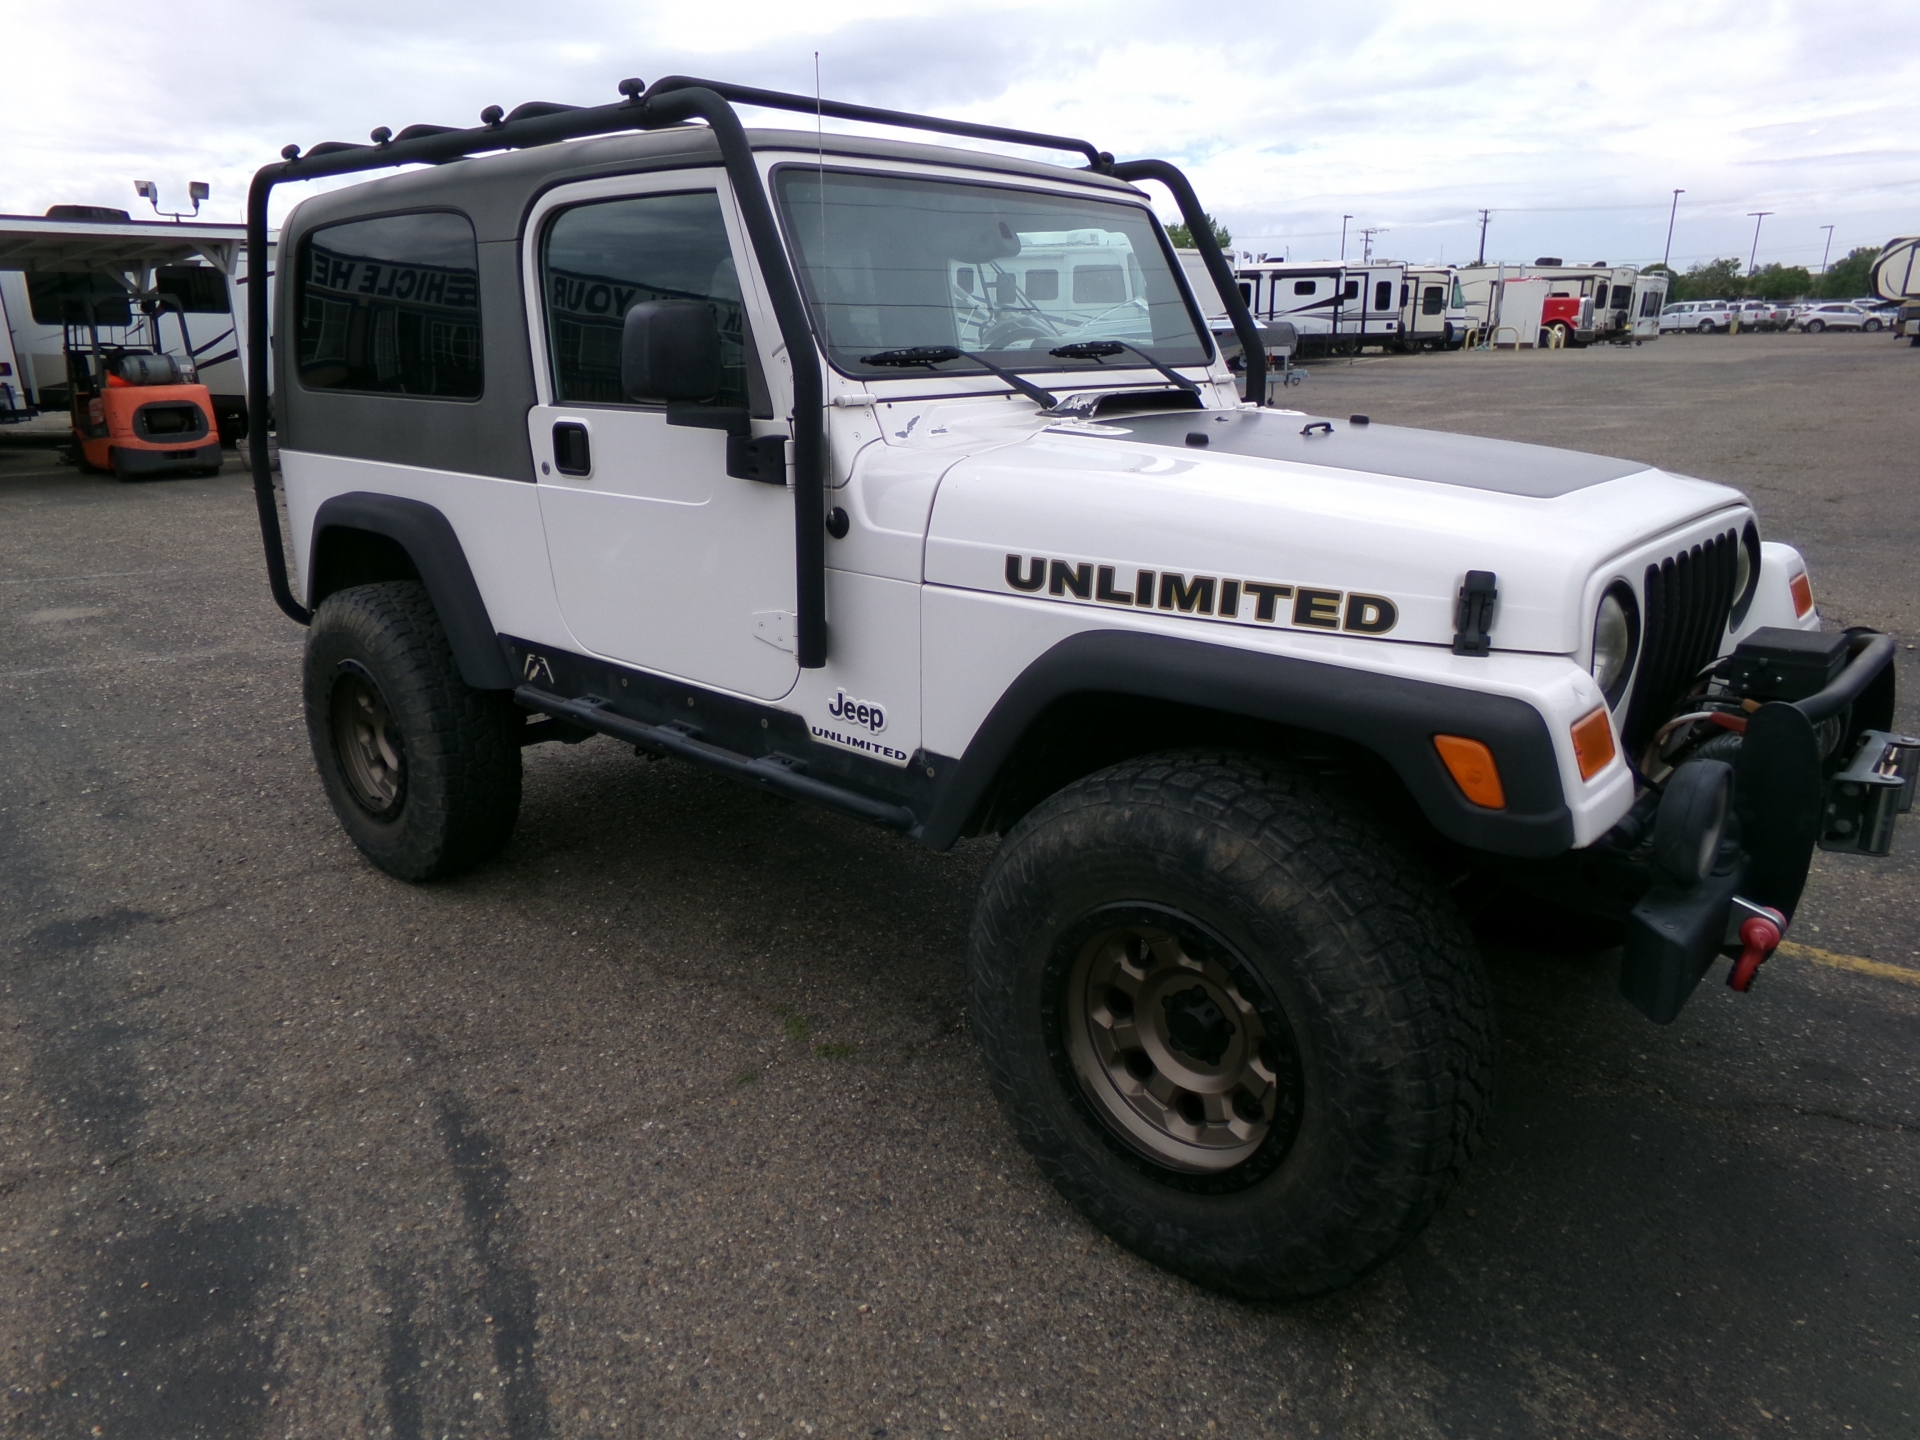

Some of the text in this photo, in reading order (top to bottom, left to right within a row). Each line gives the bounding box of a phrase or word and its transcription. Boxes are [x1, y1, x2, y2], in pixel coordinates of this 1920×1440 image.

[1004, 553, 1400, 635] UNLIMITED
[828, 690, 885, 732] Jeep
[812, 726, 908, 761] UNLIMITED
